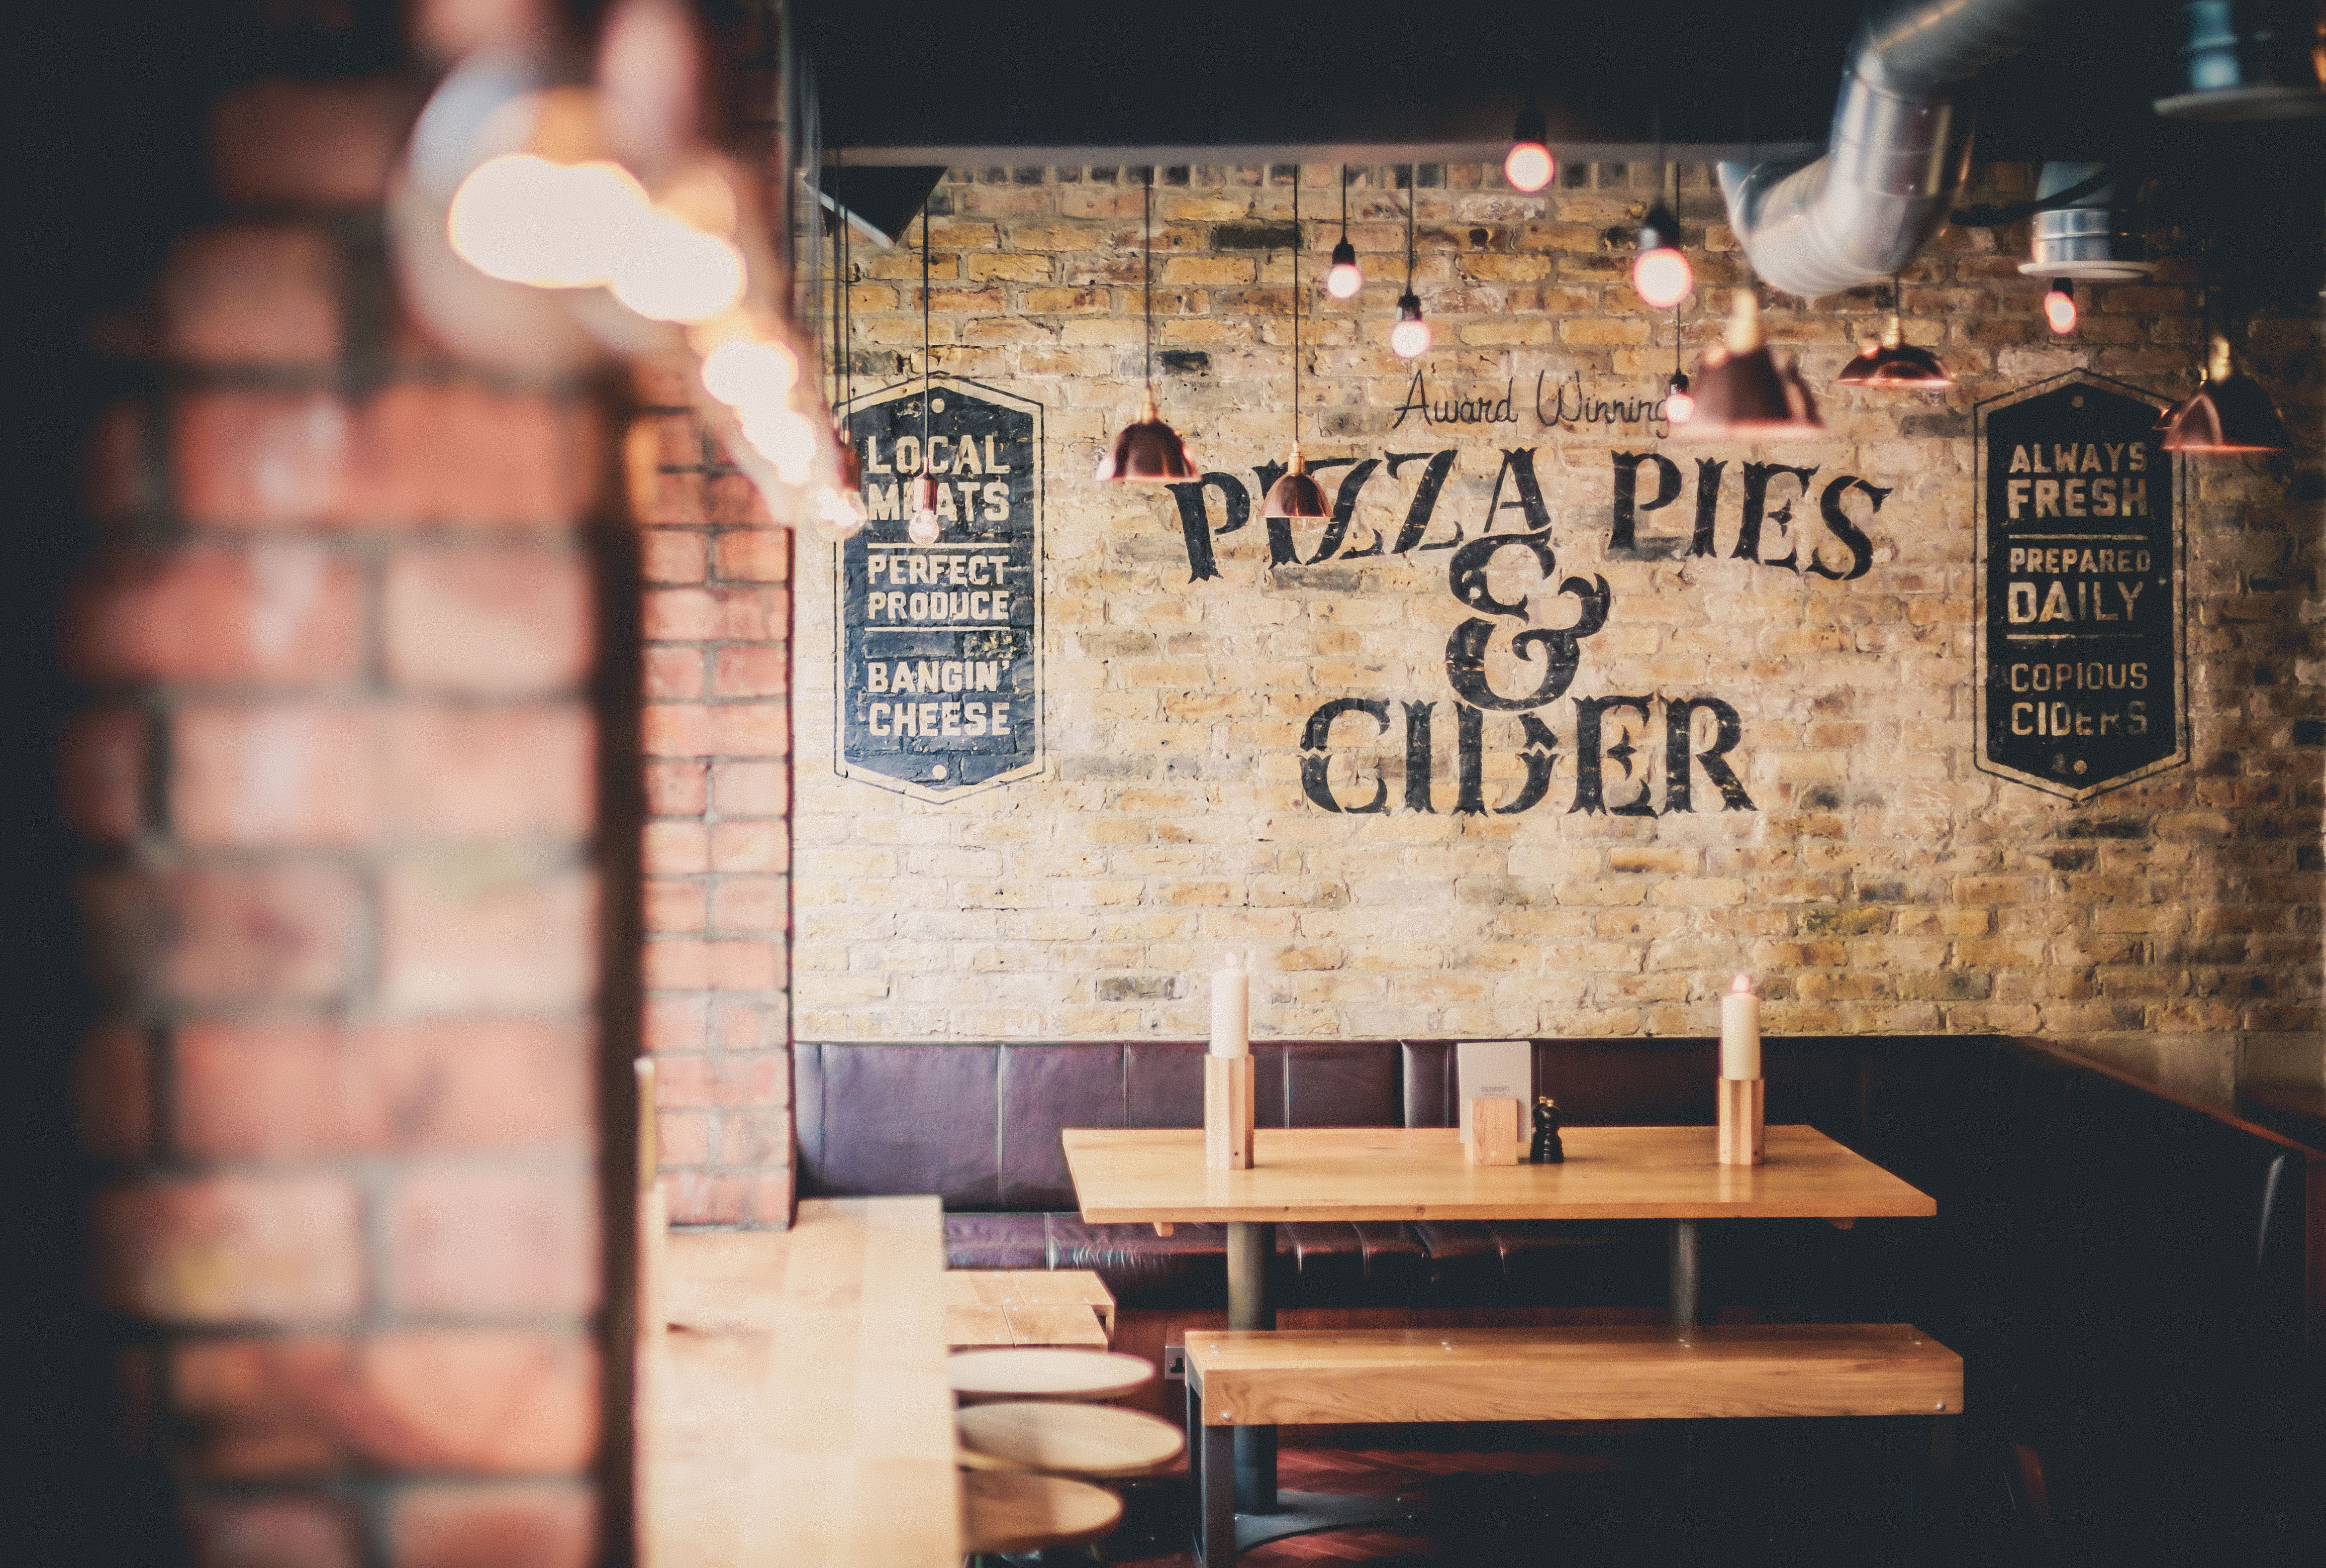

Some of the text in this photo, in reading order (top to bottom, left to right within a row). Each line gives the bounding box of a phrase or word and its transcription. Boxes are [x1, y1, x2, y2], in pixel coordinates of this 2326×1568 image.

[1393, 369, 1670, 439] Award Winning
[868, 435, 1010, 474] LOCAL
[2009, 442, 2148, 473] ALWAYS
[1165, 447, 1893, 584] PIZZA PIES
[2008, 478, 2147, 519] FRESH
[868, 555, 1009, 585] PERFECT
[2010, 548, 2151, 573] PREPARED
[867, 591, 1009, 620] PRODUCE
[1445, 528, 1610, 711] &
[2007, 581, 2145, 623] DAILY
[868, 661, 1009, 693] BANGIN'
[2011, 662, 2148, 692] COPIOUS
[869, 702, 1011, 737] CHEESE
[1300, 692, 1758, 817] CIDER
